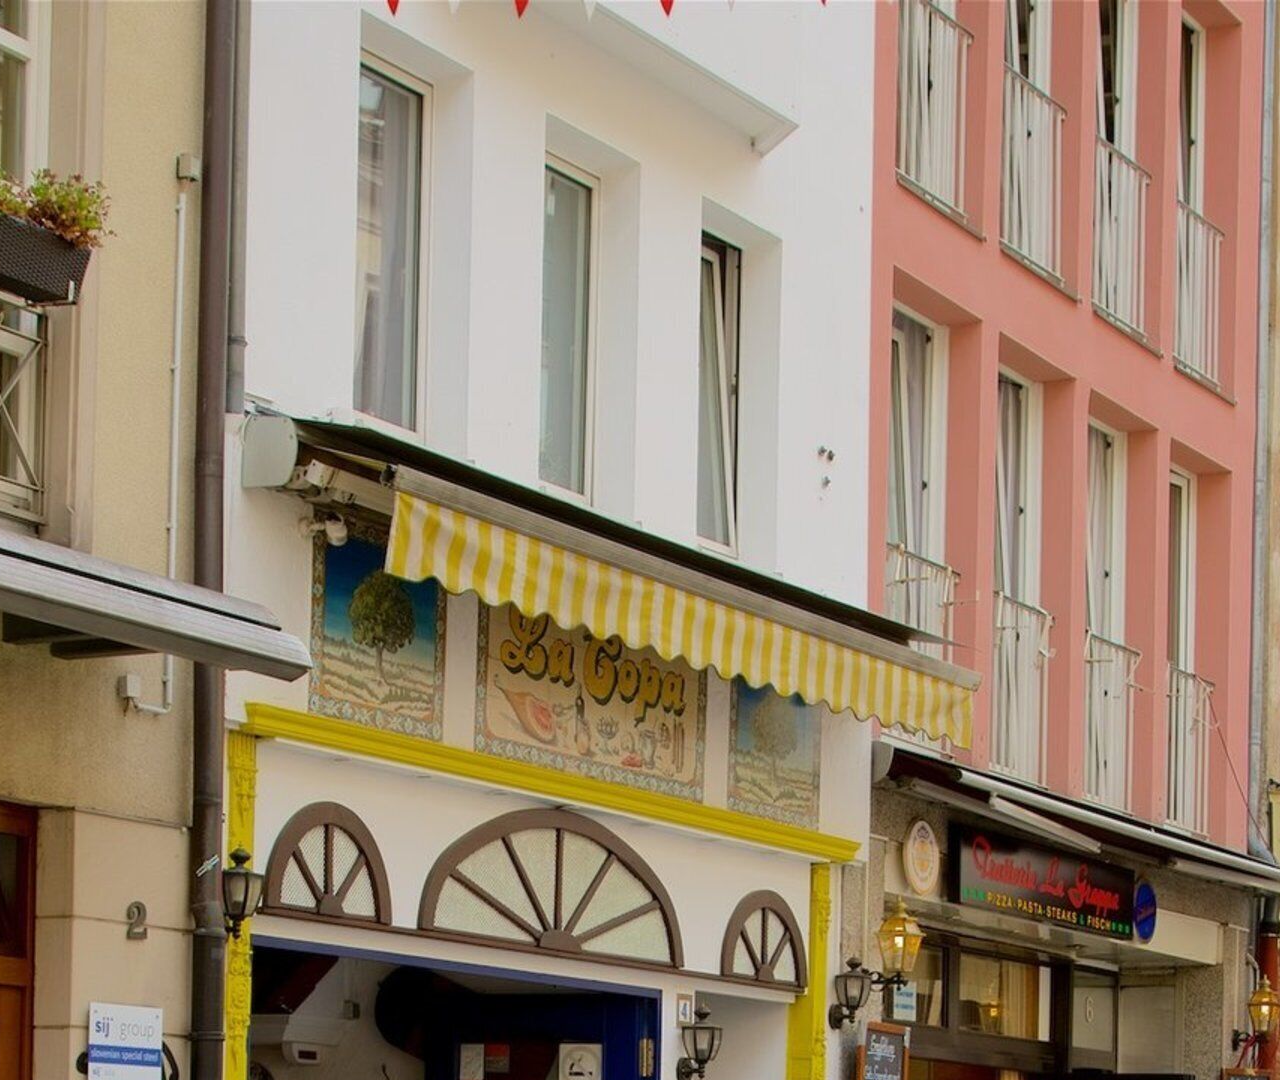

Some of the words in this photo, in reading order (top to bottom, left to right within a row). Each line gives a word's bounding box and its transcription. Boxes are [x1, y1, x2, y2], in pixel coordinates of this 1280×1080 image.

[499, 601, 575, 688] La
[581, 633, 686, 727] Copa
[1038, 856, 1066, 899] La
[126, 901, 148, 940] 2
[986, 892, 1013, 909] PIZZA
[1017, 899, 1042, 916] PASTA
[1046, 905, 1078, 925] STEAKS
[1086, 914, 1111, 932] FISCH
[681, 1002, 688, 1019] 4
[1086, 996, 1094, 1023] 6
[120, 1022, 155, 1041] group
